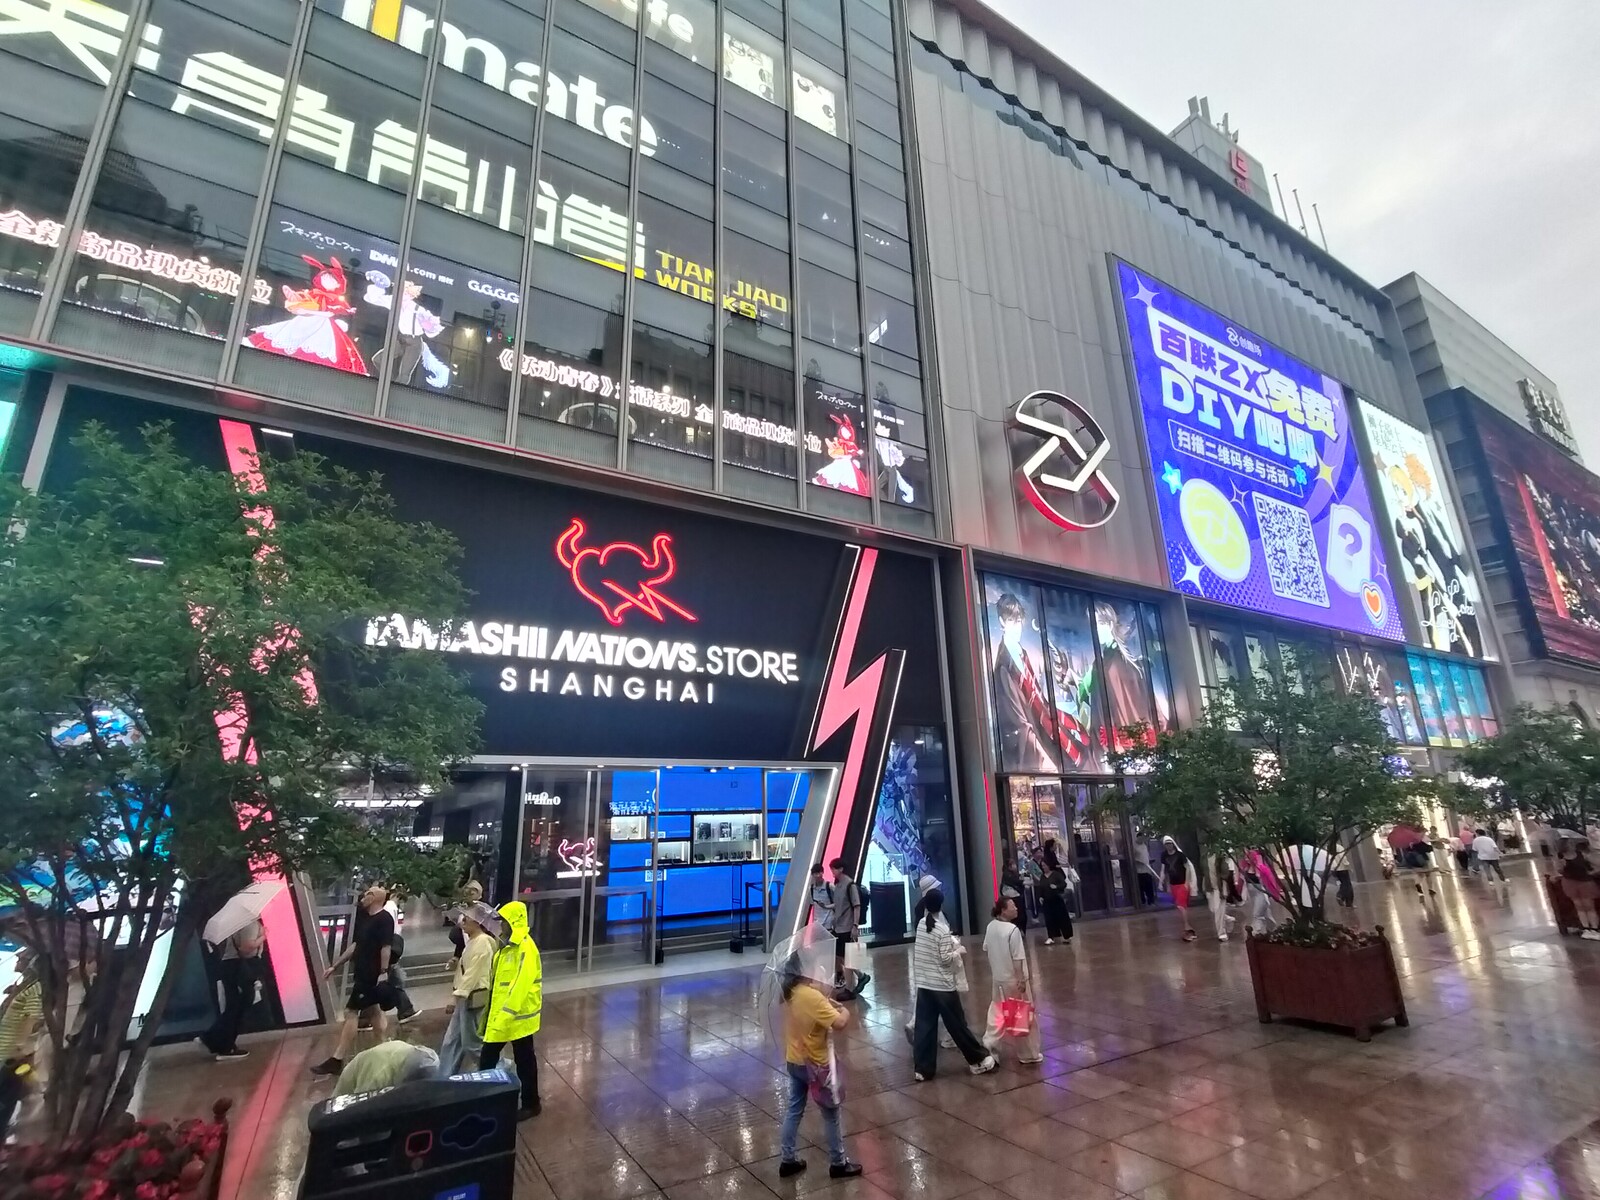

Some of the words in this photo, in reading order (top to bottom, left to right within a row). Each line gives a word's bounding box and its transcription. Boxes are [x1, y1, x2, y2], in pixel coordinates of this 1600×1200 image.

[655, 269, 757, 320] WORKS
[732, 280, 788, 313] JIAO
[365, 612, 547, 660] TAMASHII
[551, 628, 697, 673] NATIONS
[707, 645, 800, 685] STORE
[500, 667, 714, 704] SHANGHAI
